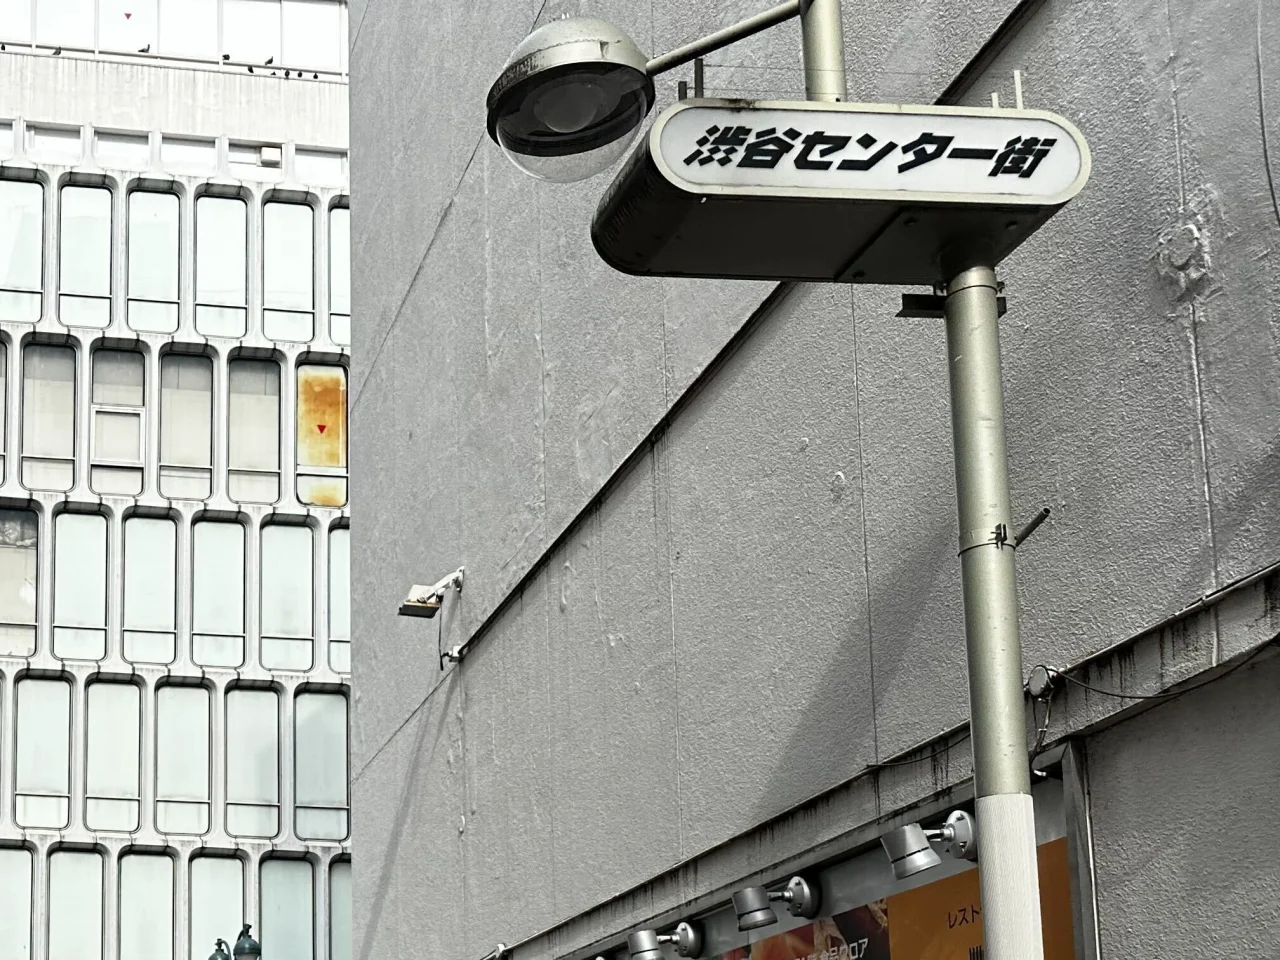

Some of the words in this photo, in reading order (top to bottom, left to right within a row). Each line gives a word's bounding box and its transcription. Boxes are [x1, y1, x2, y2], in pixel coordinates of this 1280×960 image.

[683, 124, 1057, 178] 渋谷センター街
[947, 904, 983, 930] レスト
